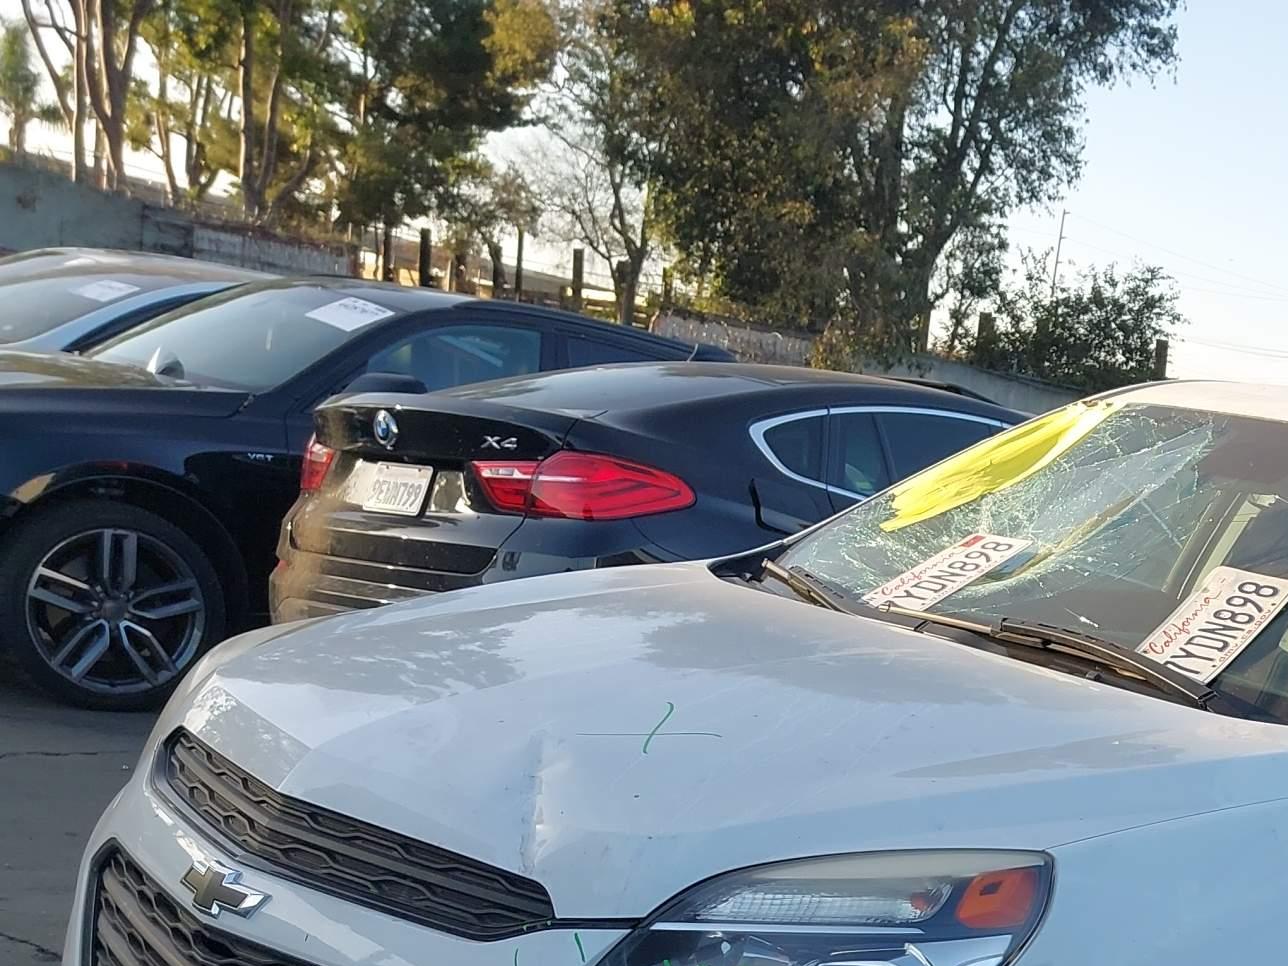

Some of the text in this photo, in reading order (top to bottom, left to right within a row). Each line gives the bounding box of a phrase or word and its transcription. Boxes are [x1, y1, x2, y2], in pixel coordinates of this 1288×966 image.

[481, 435, 518, 449] X4
[1148, 591, 1222, 655] California
[1163, 581, 1280, 675] 7YDN898
